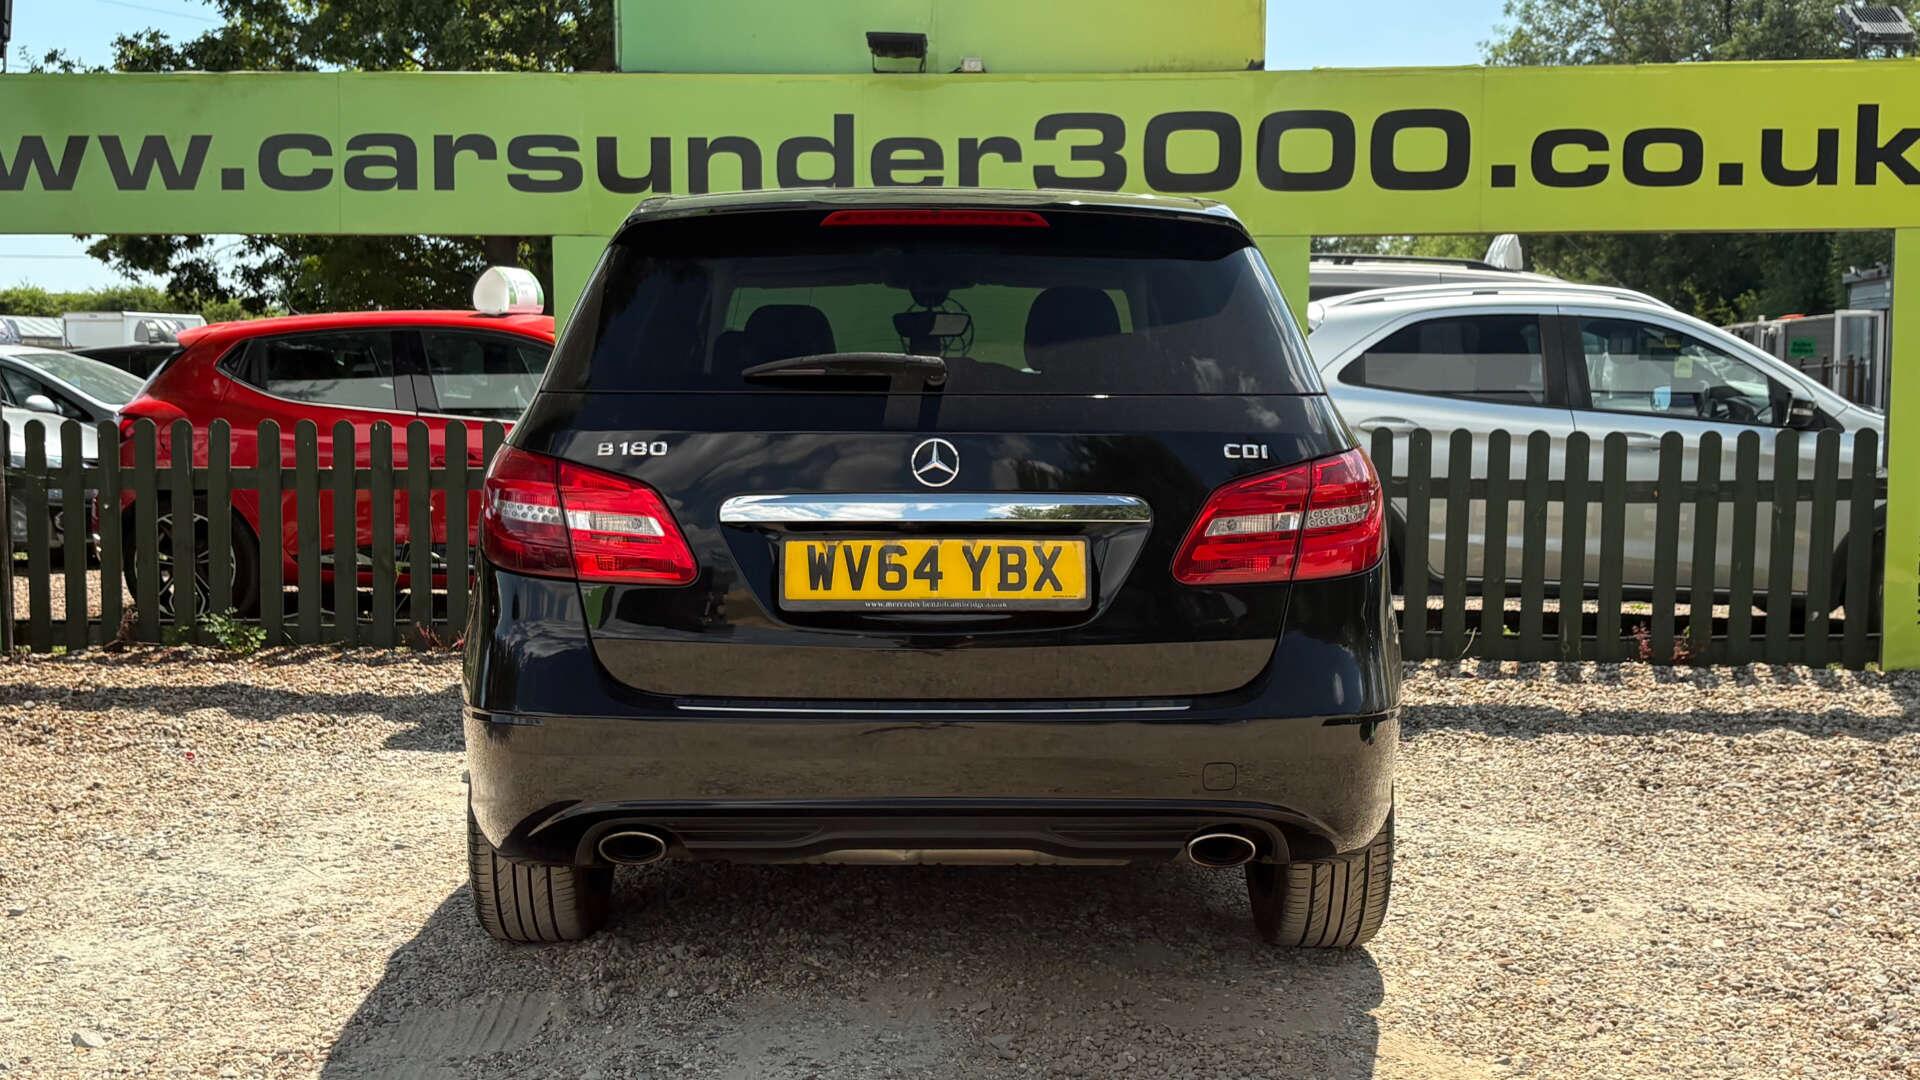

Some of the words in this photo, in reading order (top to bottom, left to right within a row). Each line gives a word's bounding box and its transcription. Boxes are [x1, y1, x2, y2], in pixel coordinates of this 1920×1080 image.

[597, 442, 614, 456] B
[619, 441, 668, 456] 180
[1223, 443, 1268, 459] CDI
[807, 545, 943, 591] WV64
[962, 546, 1063, 592] YBX
